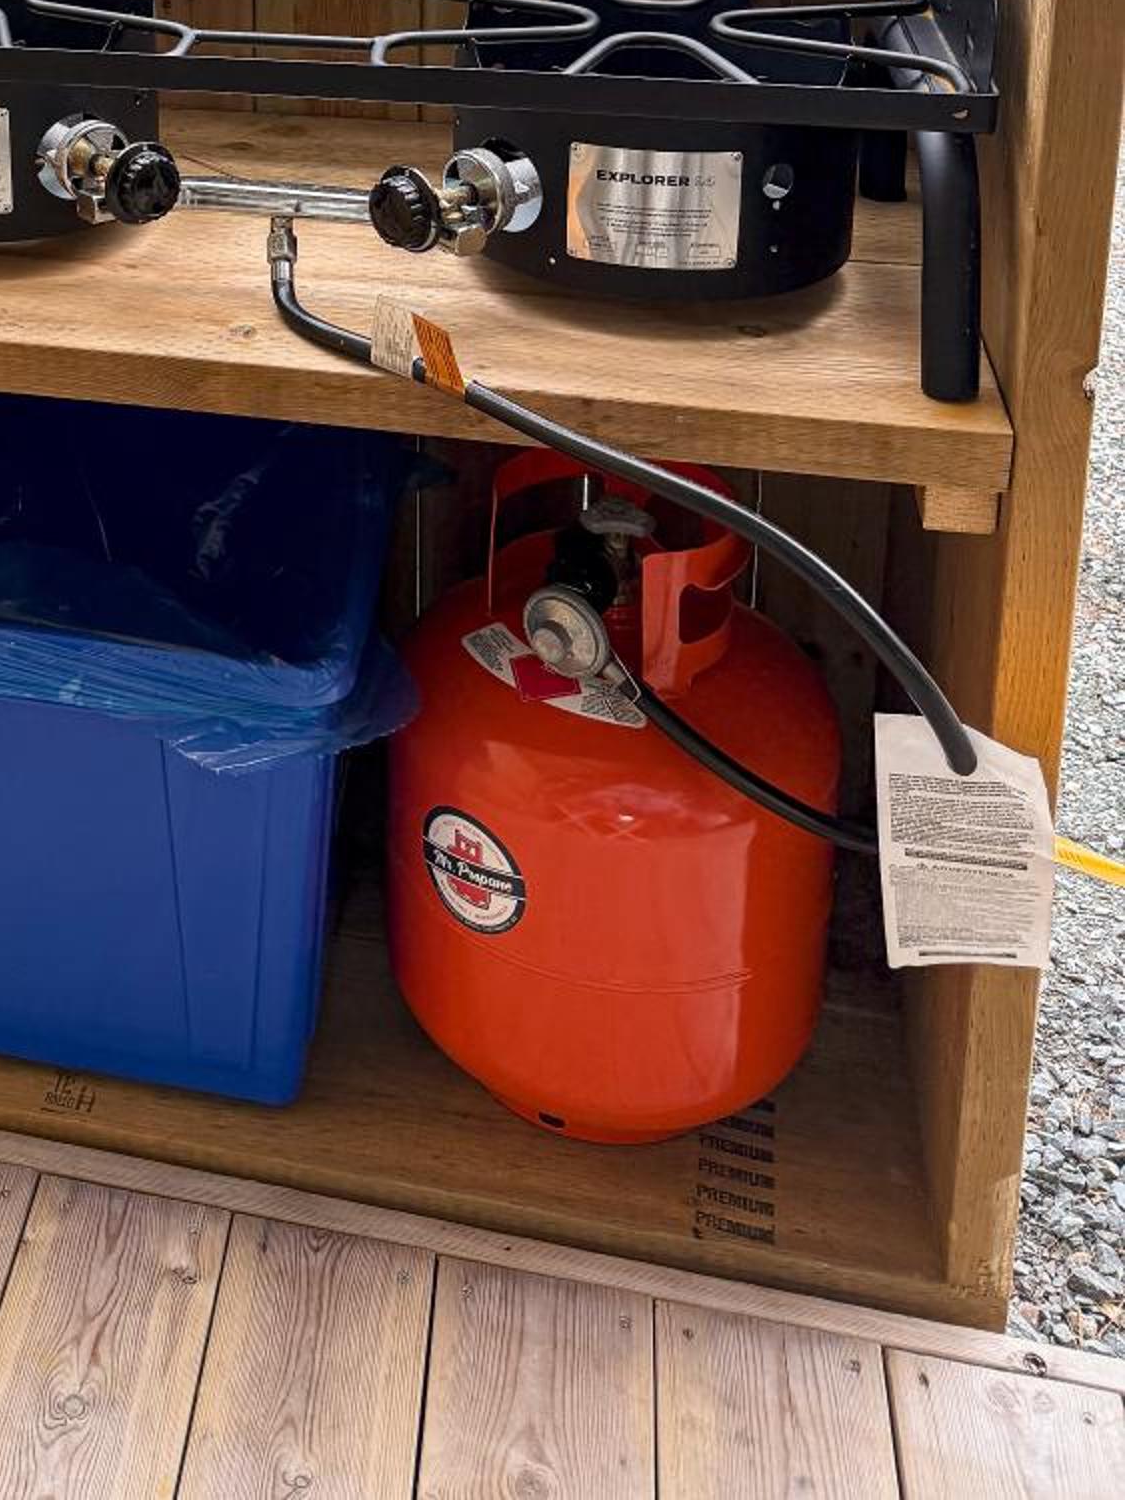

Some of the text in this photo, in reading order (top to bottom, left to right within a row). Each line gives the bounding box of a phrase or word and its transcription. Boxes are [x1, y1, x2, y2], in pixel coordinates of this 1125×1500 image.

[596, 169, 690, 187] EXPLORER
[458, 860, 513, 893] Propane
[698, 1158, 775, 1189] PREMIUM
[696, 1184, 775, 1217] PREMIUM
[695, 1210, 775, 1245] PREMIUM
